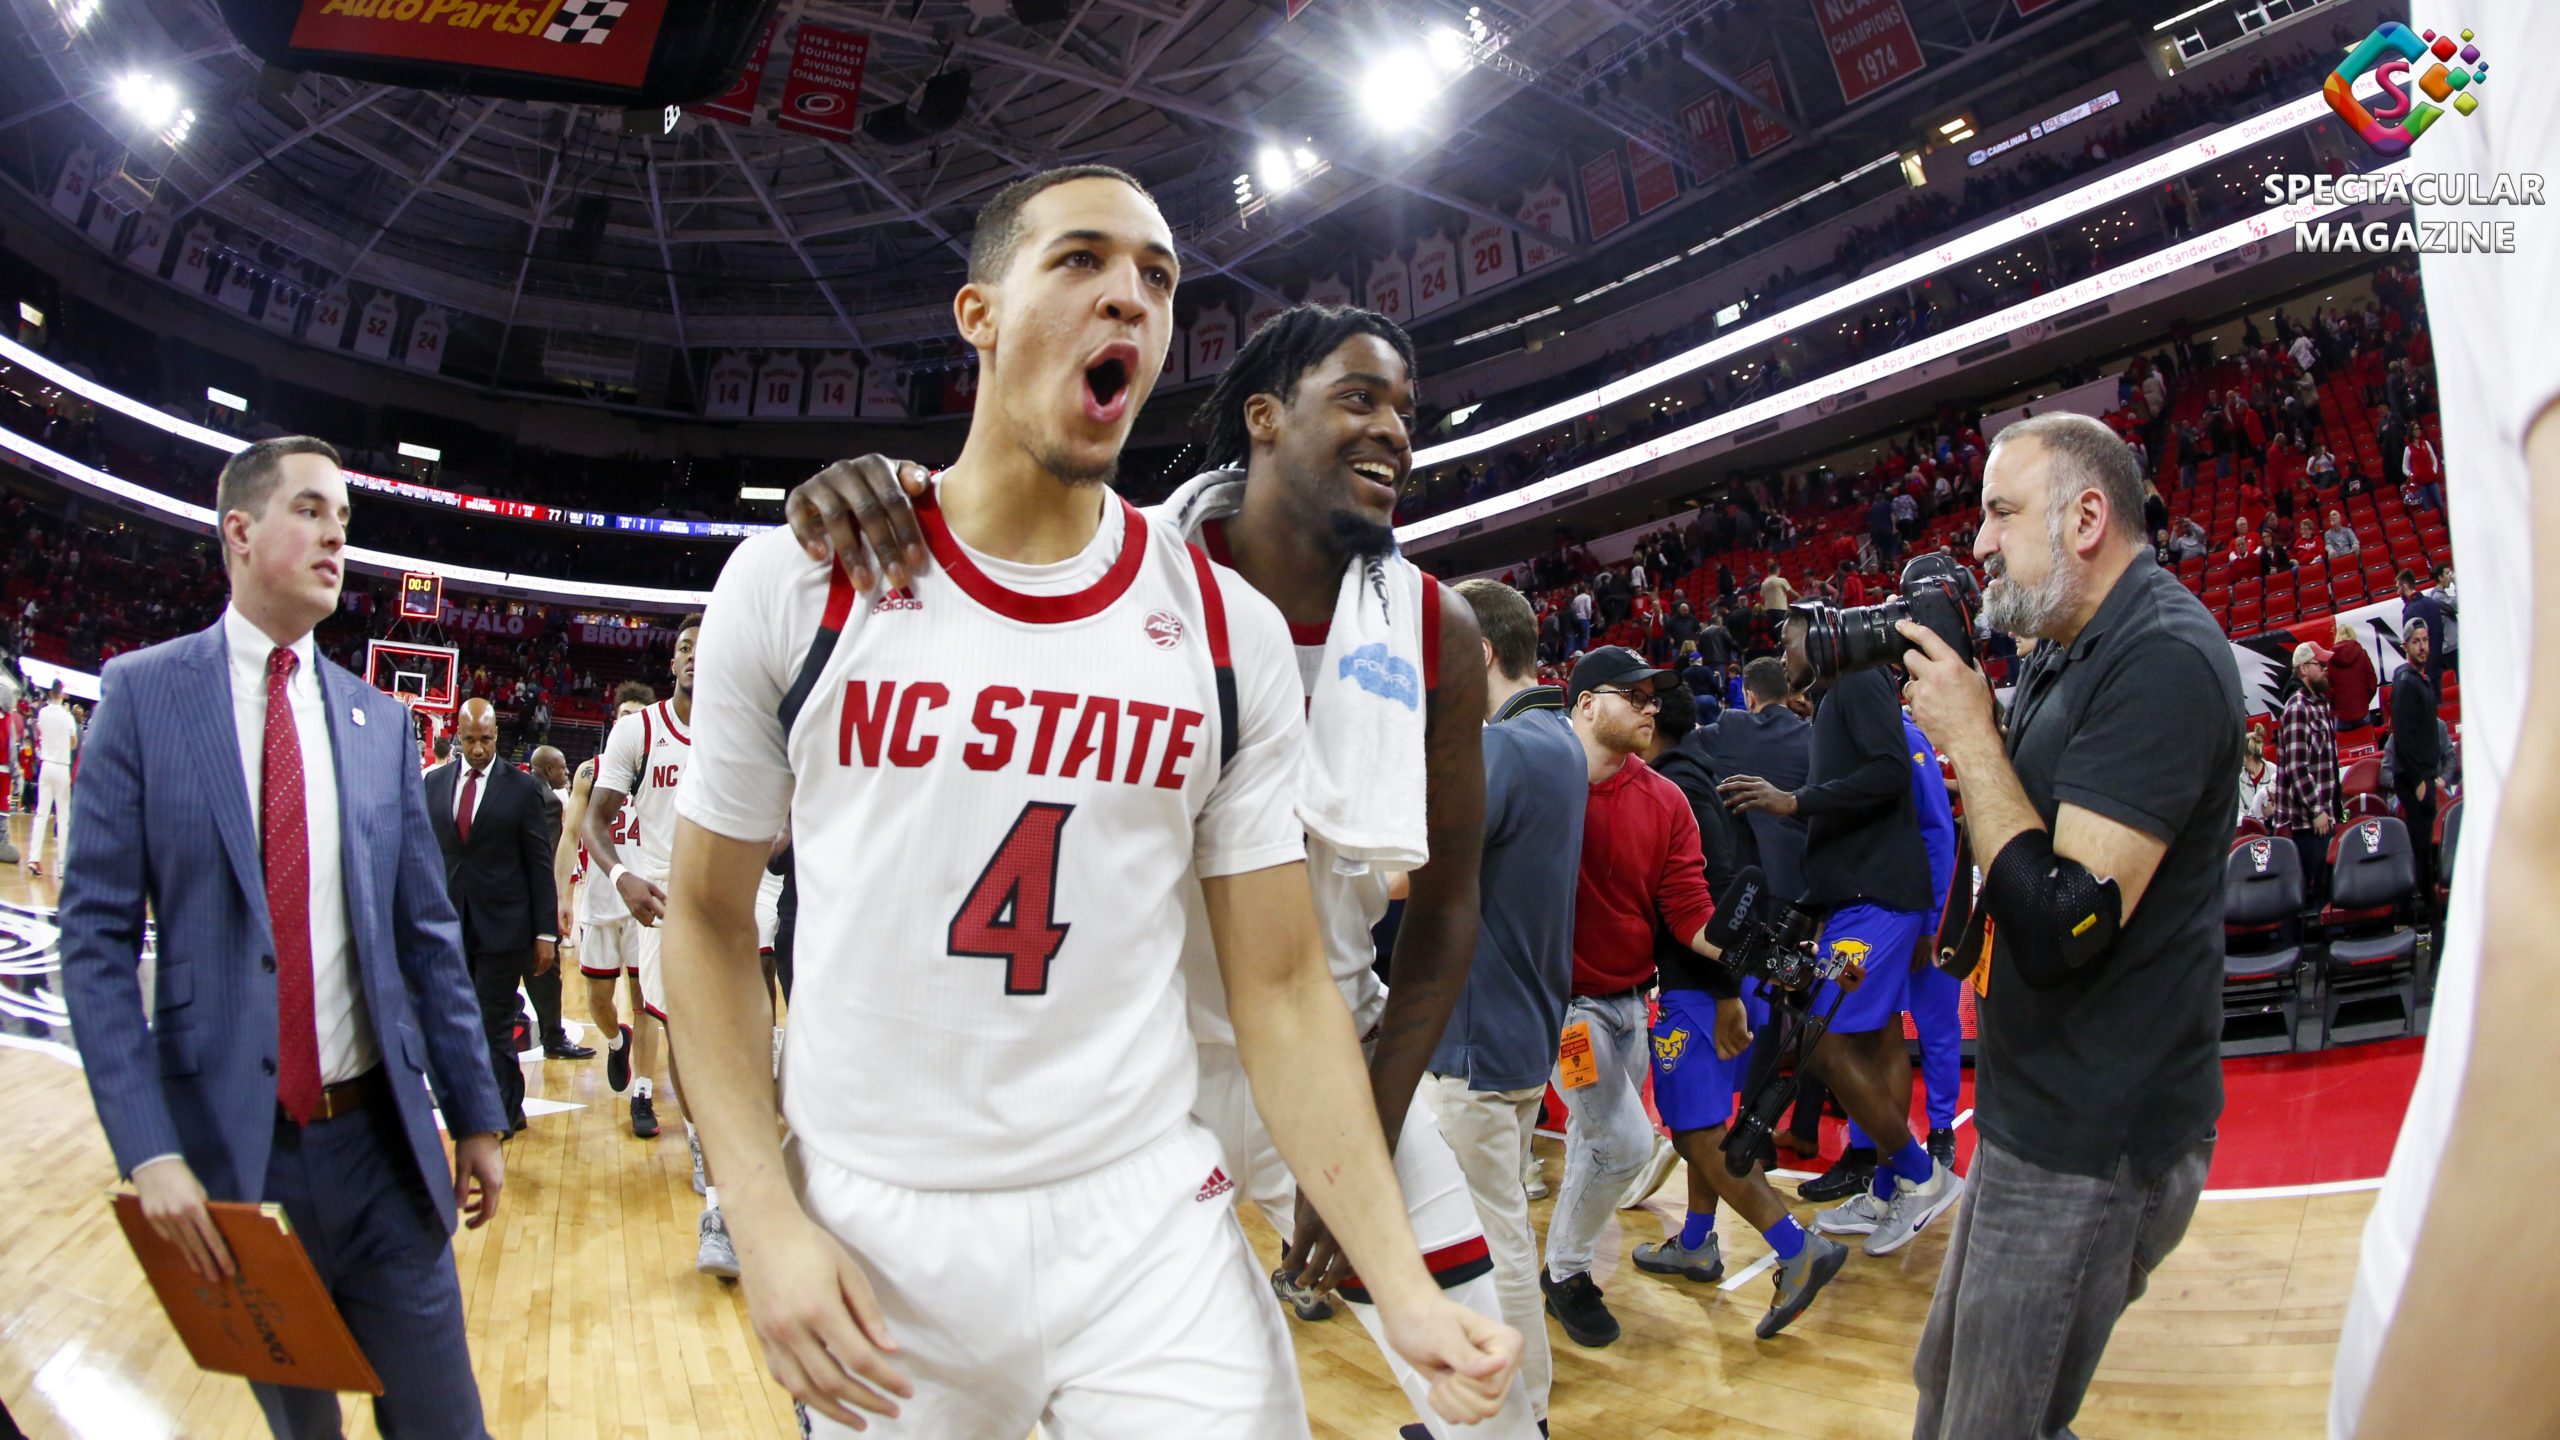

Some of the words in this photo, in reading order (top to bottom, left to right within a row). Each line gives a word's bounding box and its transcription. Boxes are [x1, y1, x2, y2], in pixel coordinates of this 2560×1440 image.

[420, 0, 533, 36] Parts
[1824, 0, 1877, 23] NCA
[1831, 8, 1902, 55] CHAMPIONS
[799, 45, 860, 65] SOUTHEAST
[802, 34, 864, 53] 1998-1999
[803, 58, 852, 77] DIVISION
[1856, 43, 1899, 84] 1974
[793, 68, 856, 90] CHAMPIONS
[1687, 99, 1719, 137] NIT
[2242, 108, 2294, 139] Download
[1987, 132, 2028, 157] CAROLINAS
[1474, 243, 1502, 275] 20
[1421, 266, 1446, 299] 24
[1376, 288, 1399, 314] 73
[318, 306, 339, 326] 24
[367, 316, 388, 338] 52
[417, 331, 439, 352] 24
[1200, 337, 1225, 364] 77
[1671, 420, 1721, 448] Download
[1882, 352, 1905, 371] App
[1909, 343, 1931, 361] and
[1934, 330, 1966, 351] claim
[1969, 319, 1996, 339] your
[2000, 307, 2028, 327] free
[2031, 279, 2104, 316] Chick-fil-A
[2108, 258, 2162, 287] Chicken
[719, 383, 740, 404] 14
[768, 382, 790, 403] 10
[823, 383, 844, 404] 14
[548, 508, 562, 521] 77
[590, 514, 605, 527] 73
[872, 597, 923, 615] adidas
[1146, 620, 1181, 636] ACC
[839, 680, 950, 768] NC
[963, 685, 1205, 790] STATE
[652, 765, 679, 788] NC
[947, 801, 1076, 995] 4
[1727, 881, 1760, 931] RØDE
